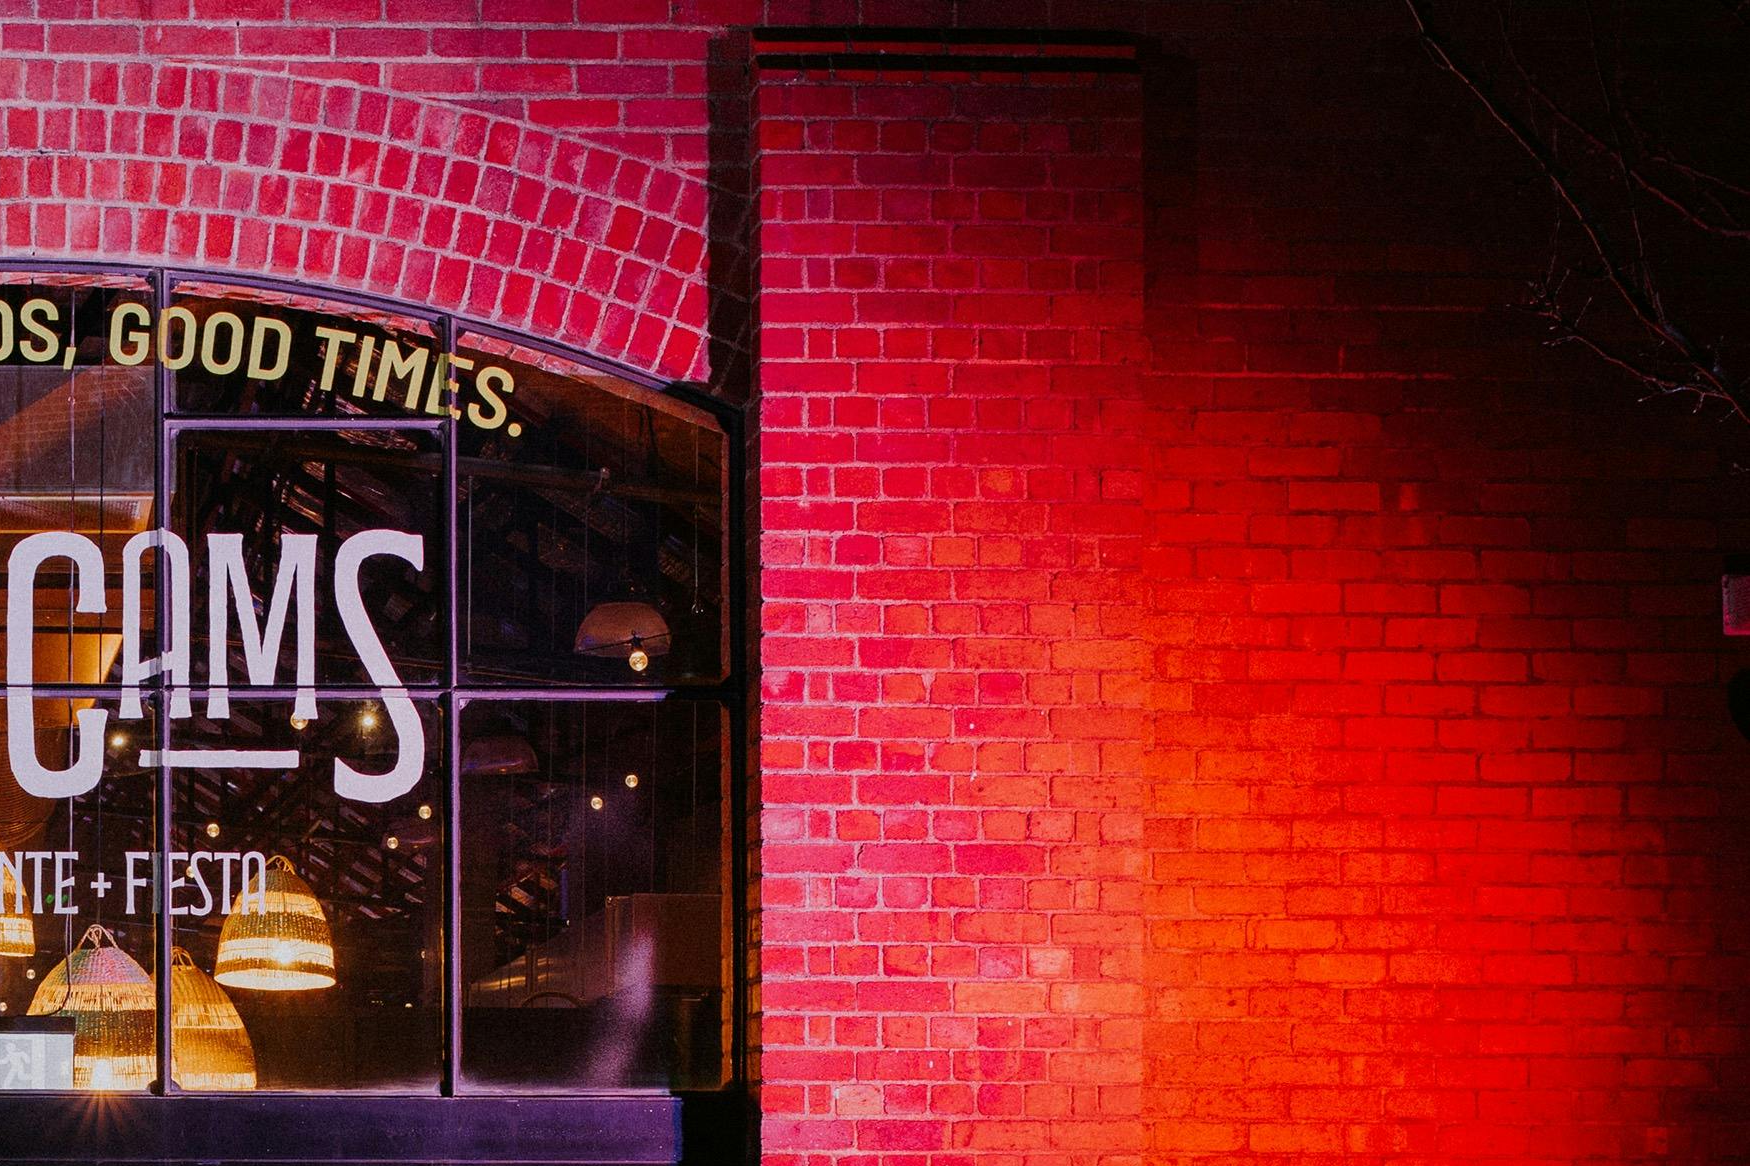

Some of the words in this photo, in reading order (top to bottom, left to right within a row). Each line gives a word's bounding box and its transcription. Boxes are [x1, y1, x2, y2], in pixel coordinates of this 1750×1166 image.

[109, 302, 292, 381] GOOD
[315, 325, 522, 437] TIMES.
[125, 850, 267, 916] FIESTA
